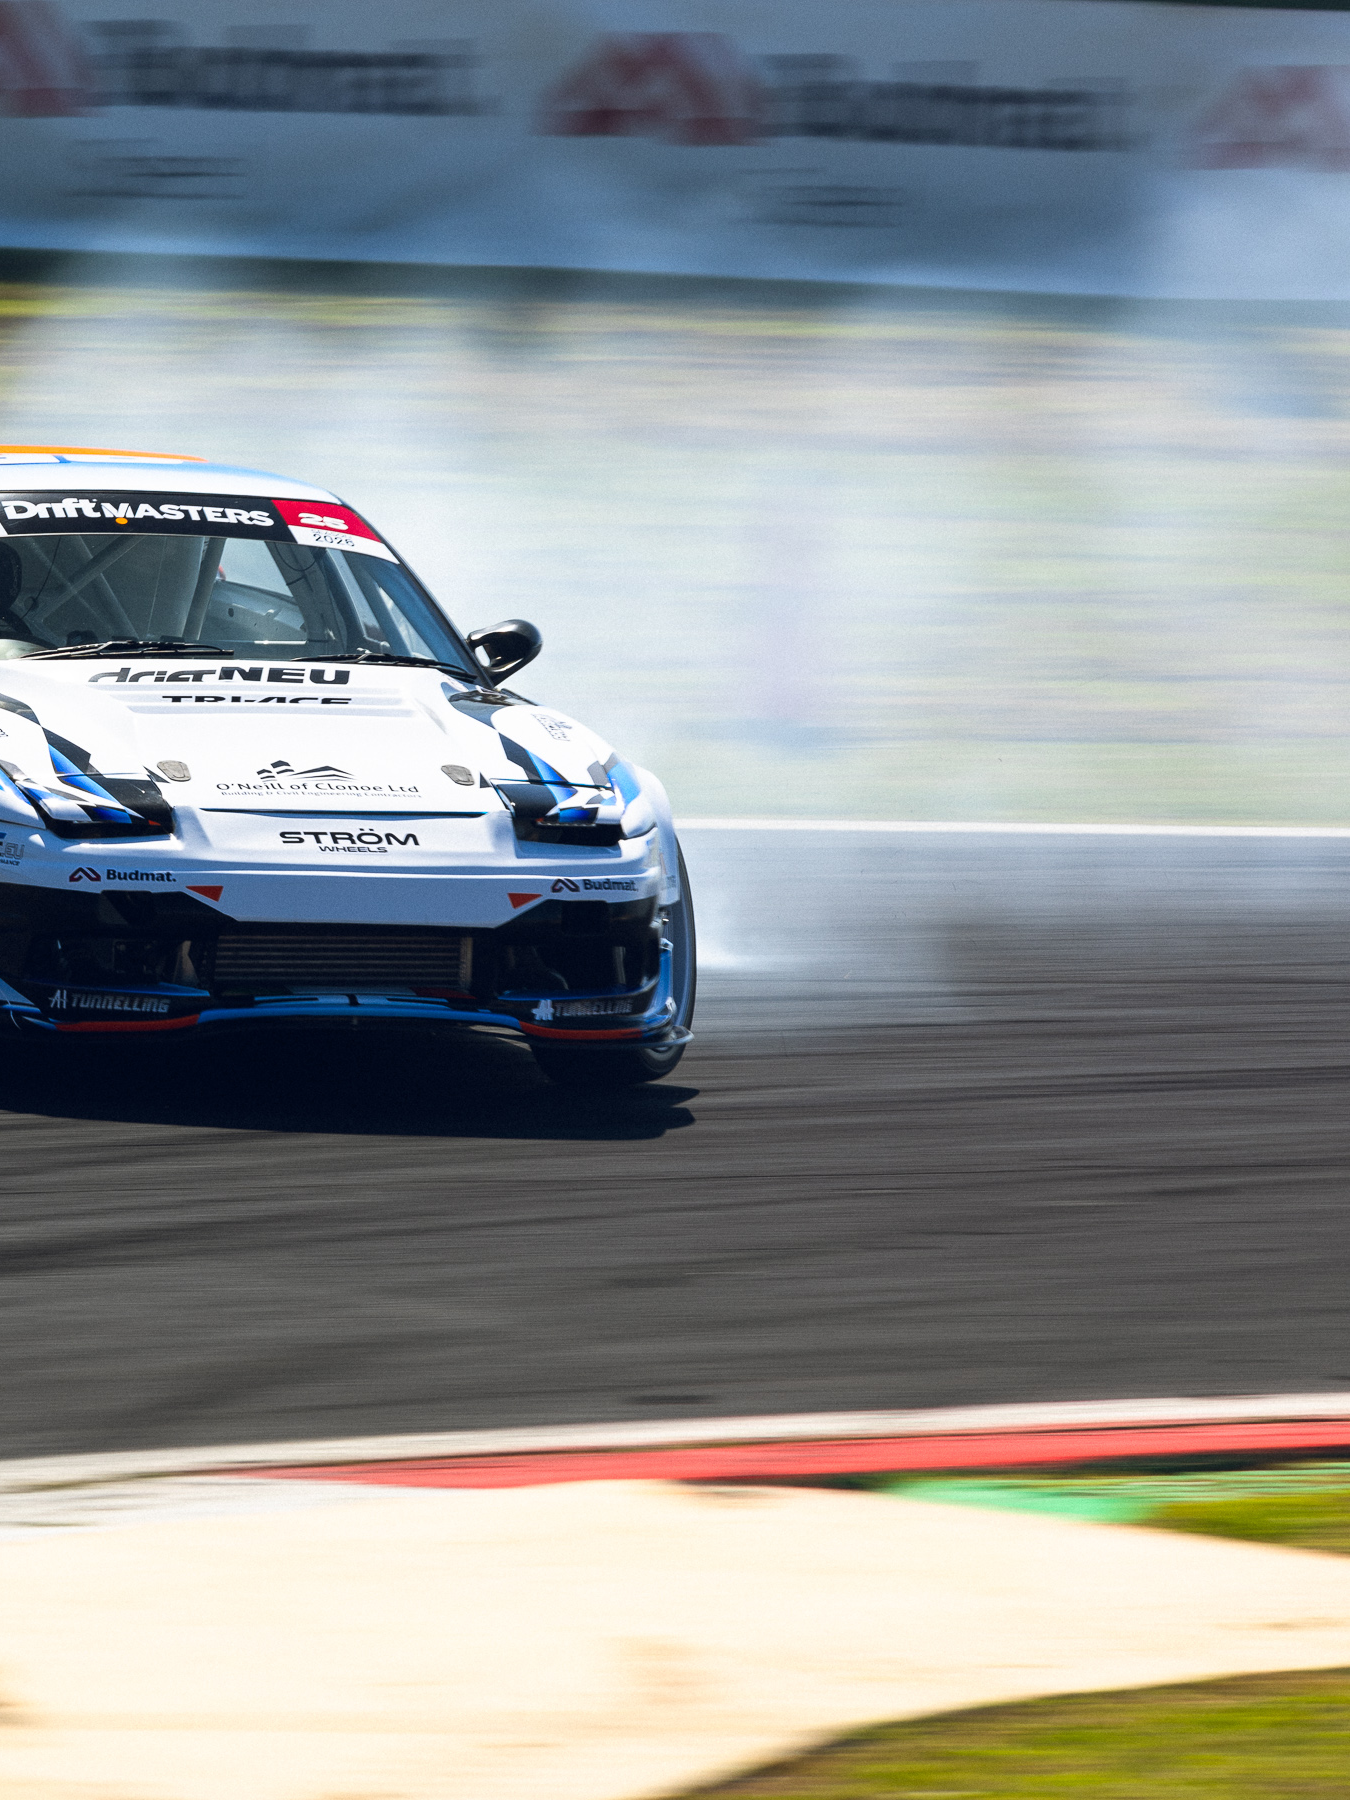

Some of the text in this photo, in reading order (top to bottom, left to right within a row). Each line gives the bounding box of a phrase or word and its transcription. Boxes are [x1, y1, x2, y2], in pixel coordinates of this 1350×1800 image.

[298, 512, 349, 531] 25
[216, 783, 419, 793] O'Neill of Clonoe Ltd
[279, 828, 421, 846] STRÖM
[319, 845, 388, 853] WHEELS
[106, 869, 177, 883] Budmat.
[583, 879, 639, 892] Budmat.
